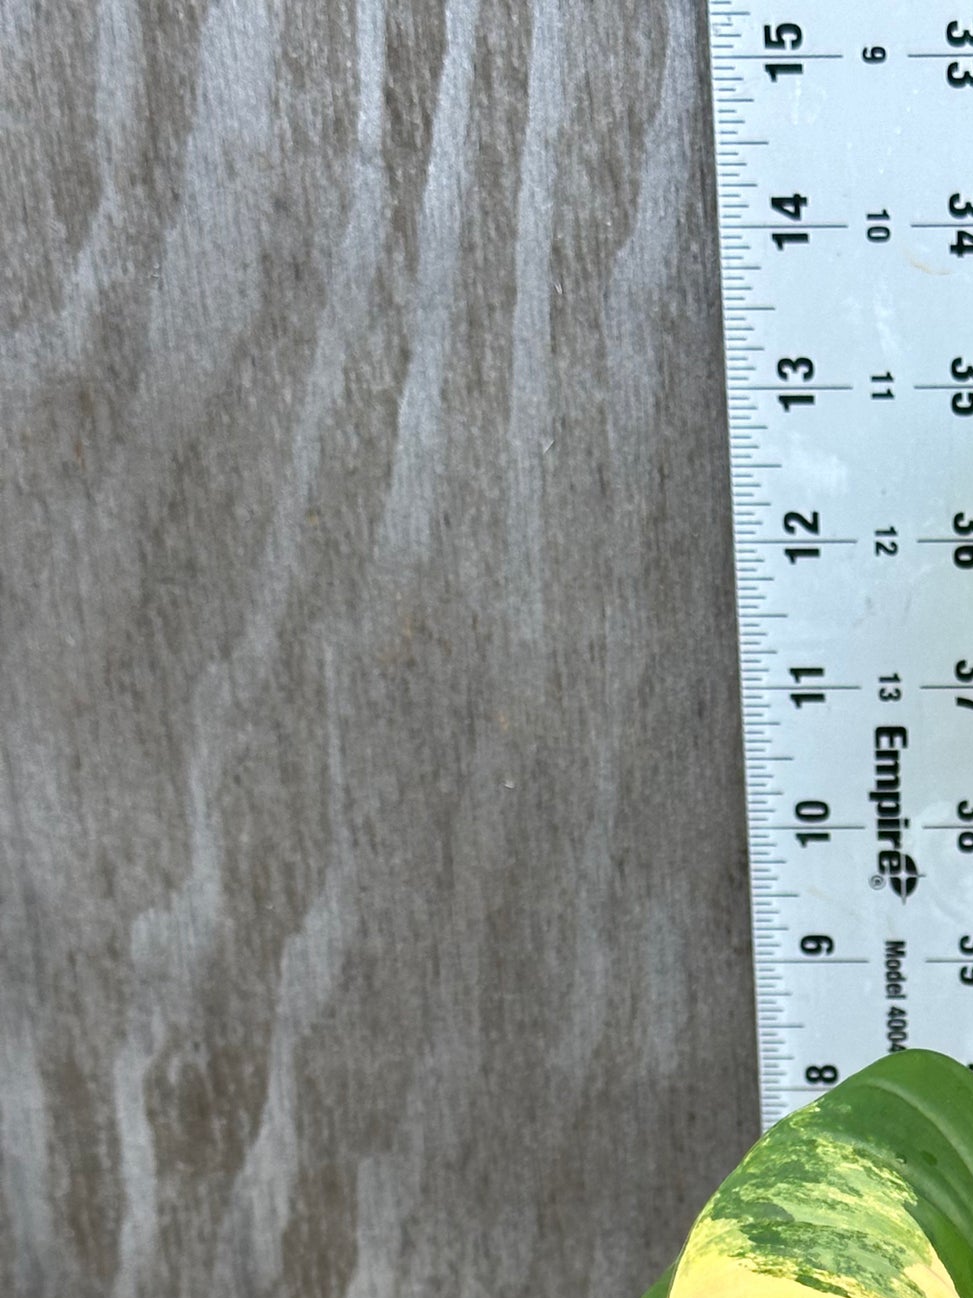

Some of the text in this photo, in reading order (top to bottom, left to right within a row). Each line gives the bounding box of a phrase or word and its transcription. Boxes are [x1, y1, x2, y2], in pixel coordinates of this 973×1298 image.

[764, 22, 804, 82] 15
[862, 46, 887, 64] 9
[771, 193, 809, 250] 14
[867, 209, 891, 243] 10
[777, 357, 815, 412] 13
[871, 371, 895, 400] 11
[783, 511, 820, 565] 12
[875, 526, 898, 557] 12
[789, 667, 825, 708] 11
[878, 672, 902, 702] 13
[868, 726, 914, 876] Empire
[795, 800, 830, 848] 10
[800, 934, 834, 956] 9
[884, 940, 908, 999] Model
[805, 1064, 839, 1085] 8
